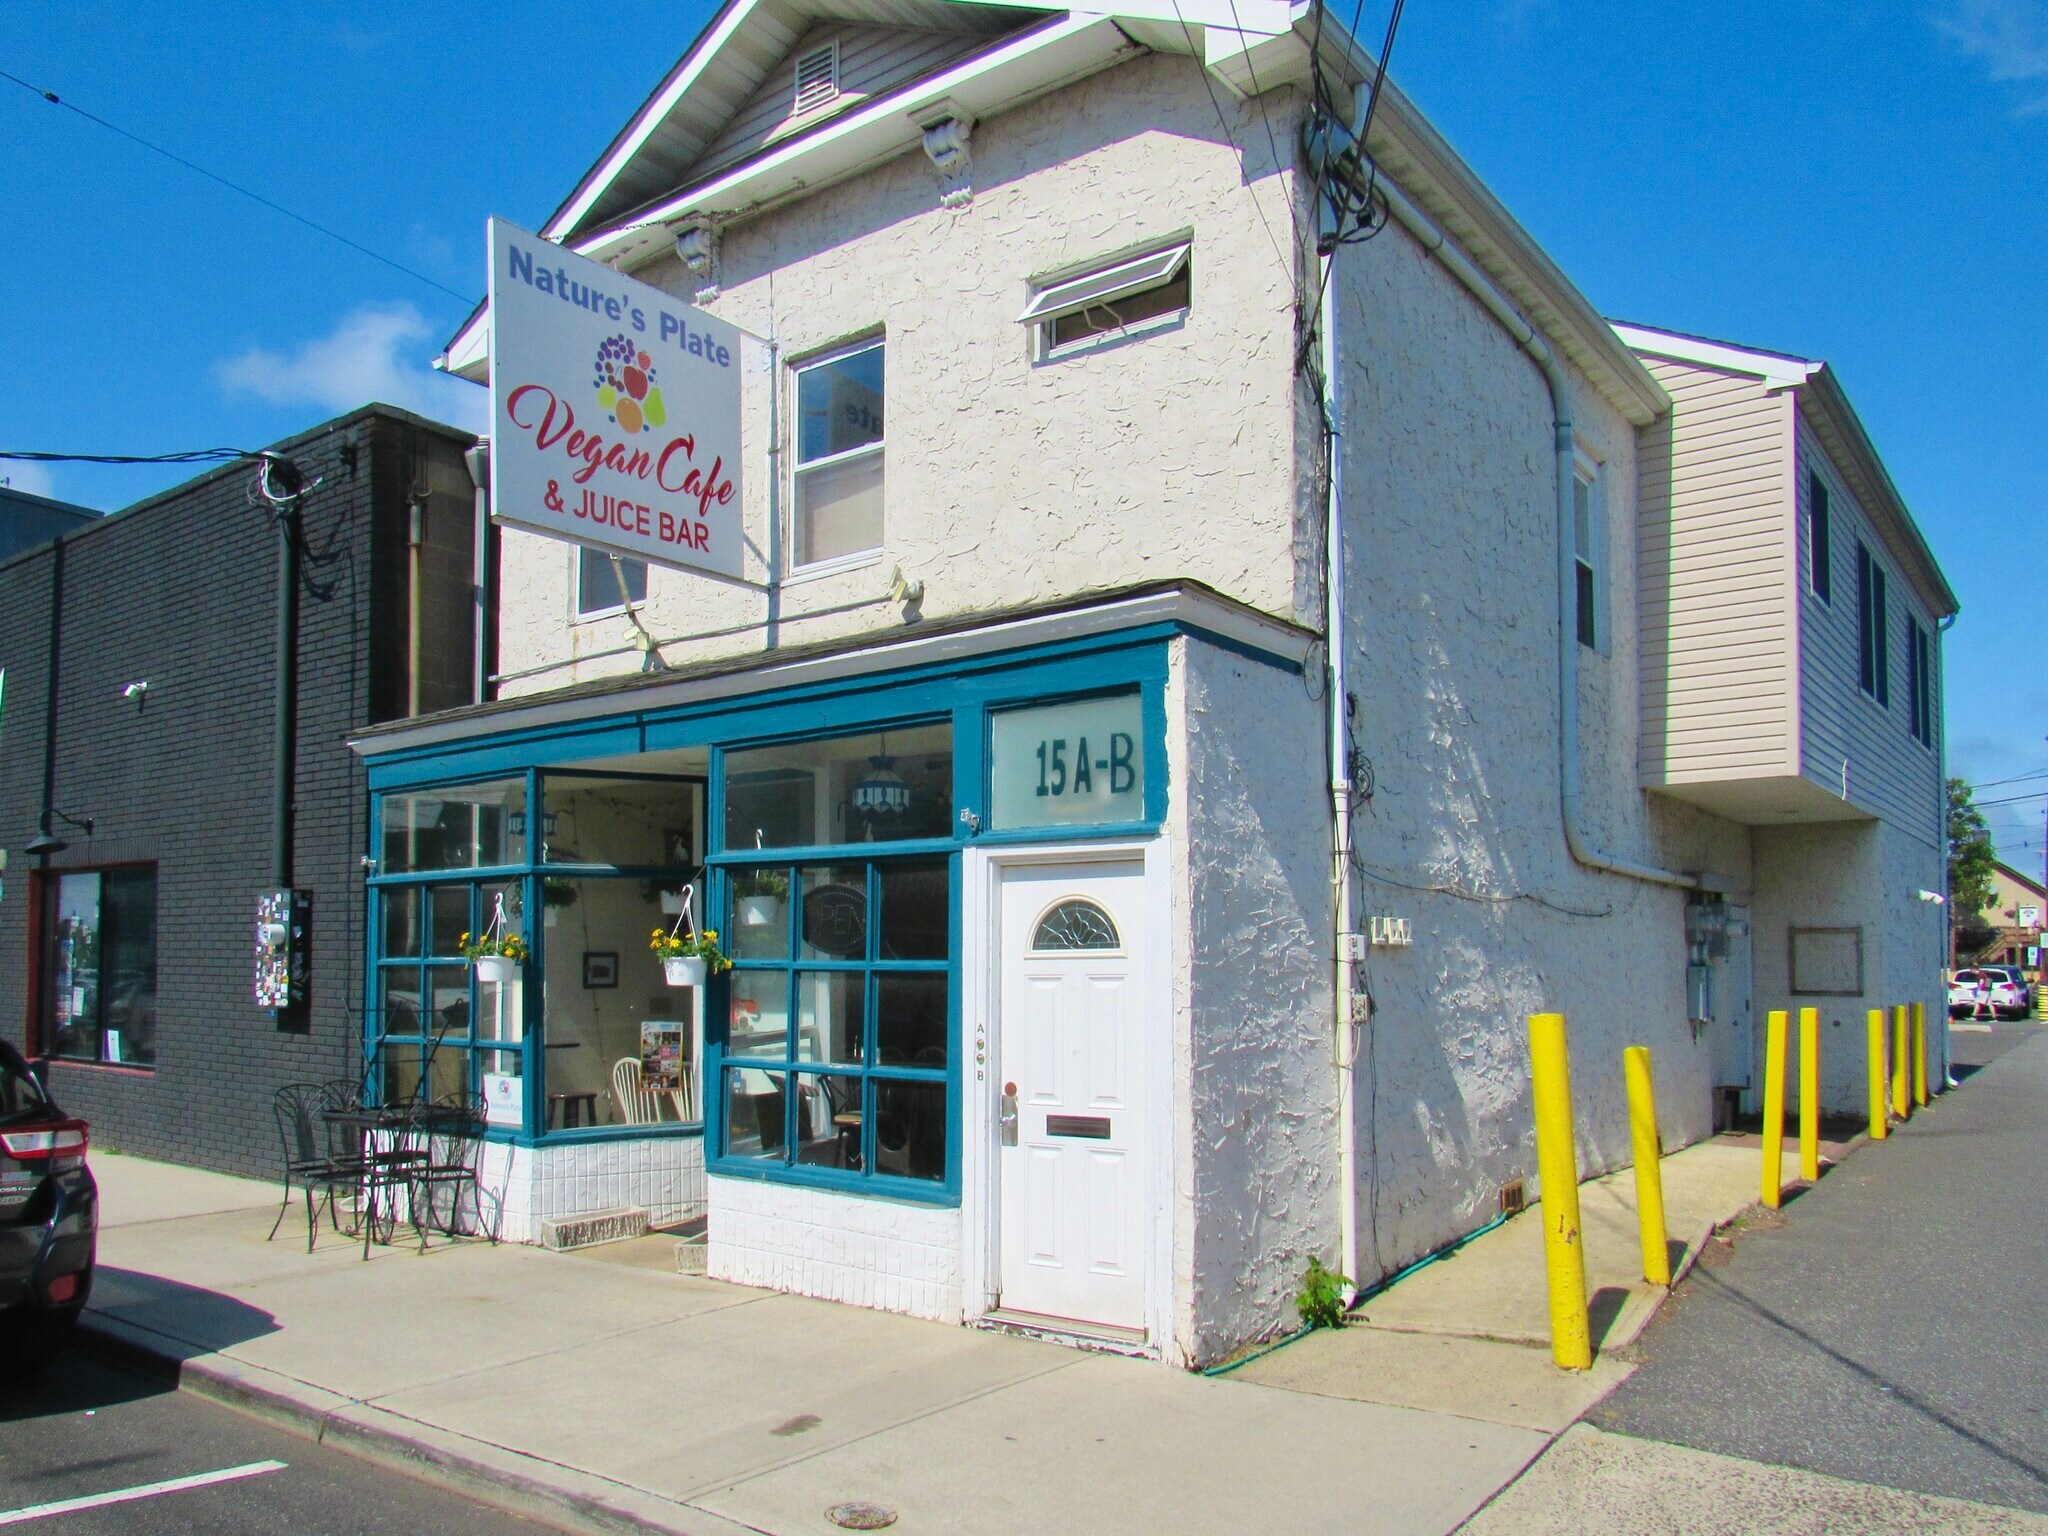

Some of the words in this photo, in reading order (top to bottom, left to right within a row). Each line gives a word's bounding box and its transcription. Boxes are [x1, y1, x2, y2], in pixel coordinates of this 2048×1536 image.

[509, 244, 646, 333] Nature's
[660, 310, 730, 368] Plate
[506, 384, 654, 484] Vegan
[656, 432, 737, 517] Cafe
[543, 478, 565, 514] &
[573, 488, 651, 536] JUICE
[659, 511, 711, 554] BAR
[976, 1022, 985, 1034] A
[976, 1070, 985, 1082] B
